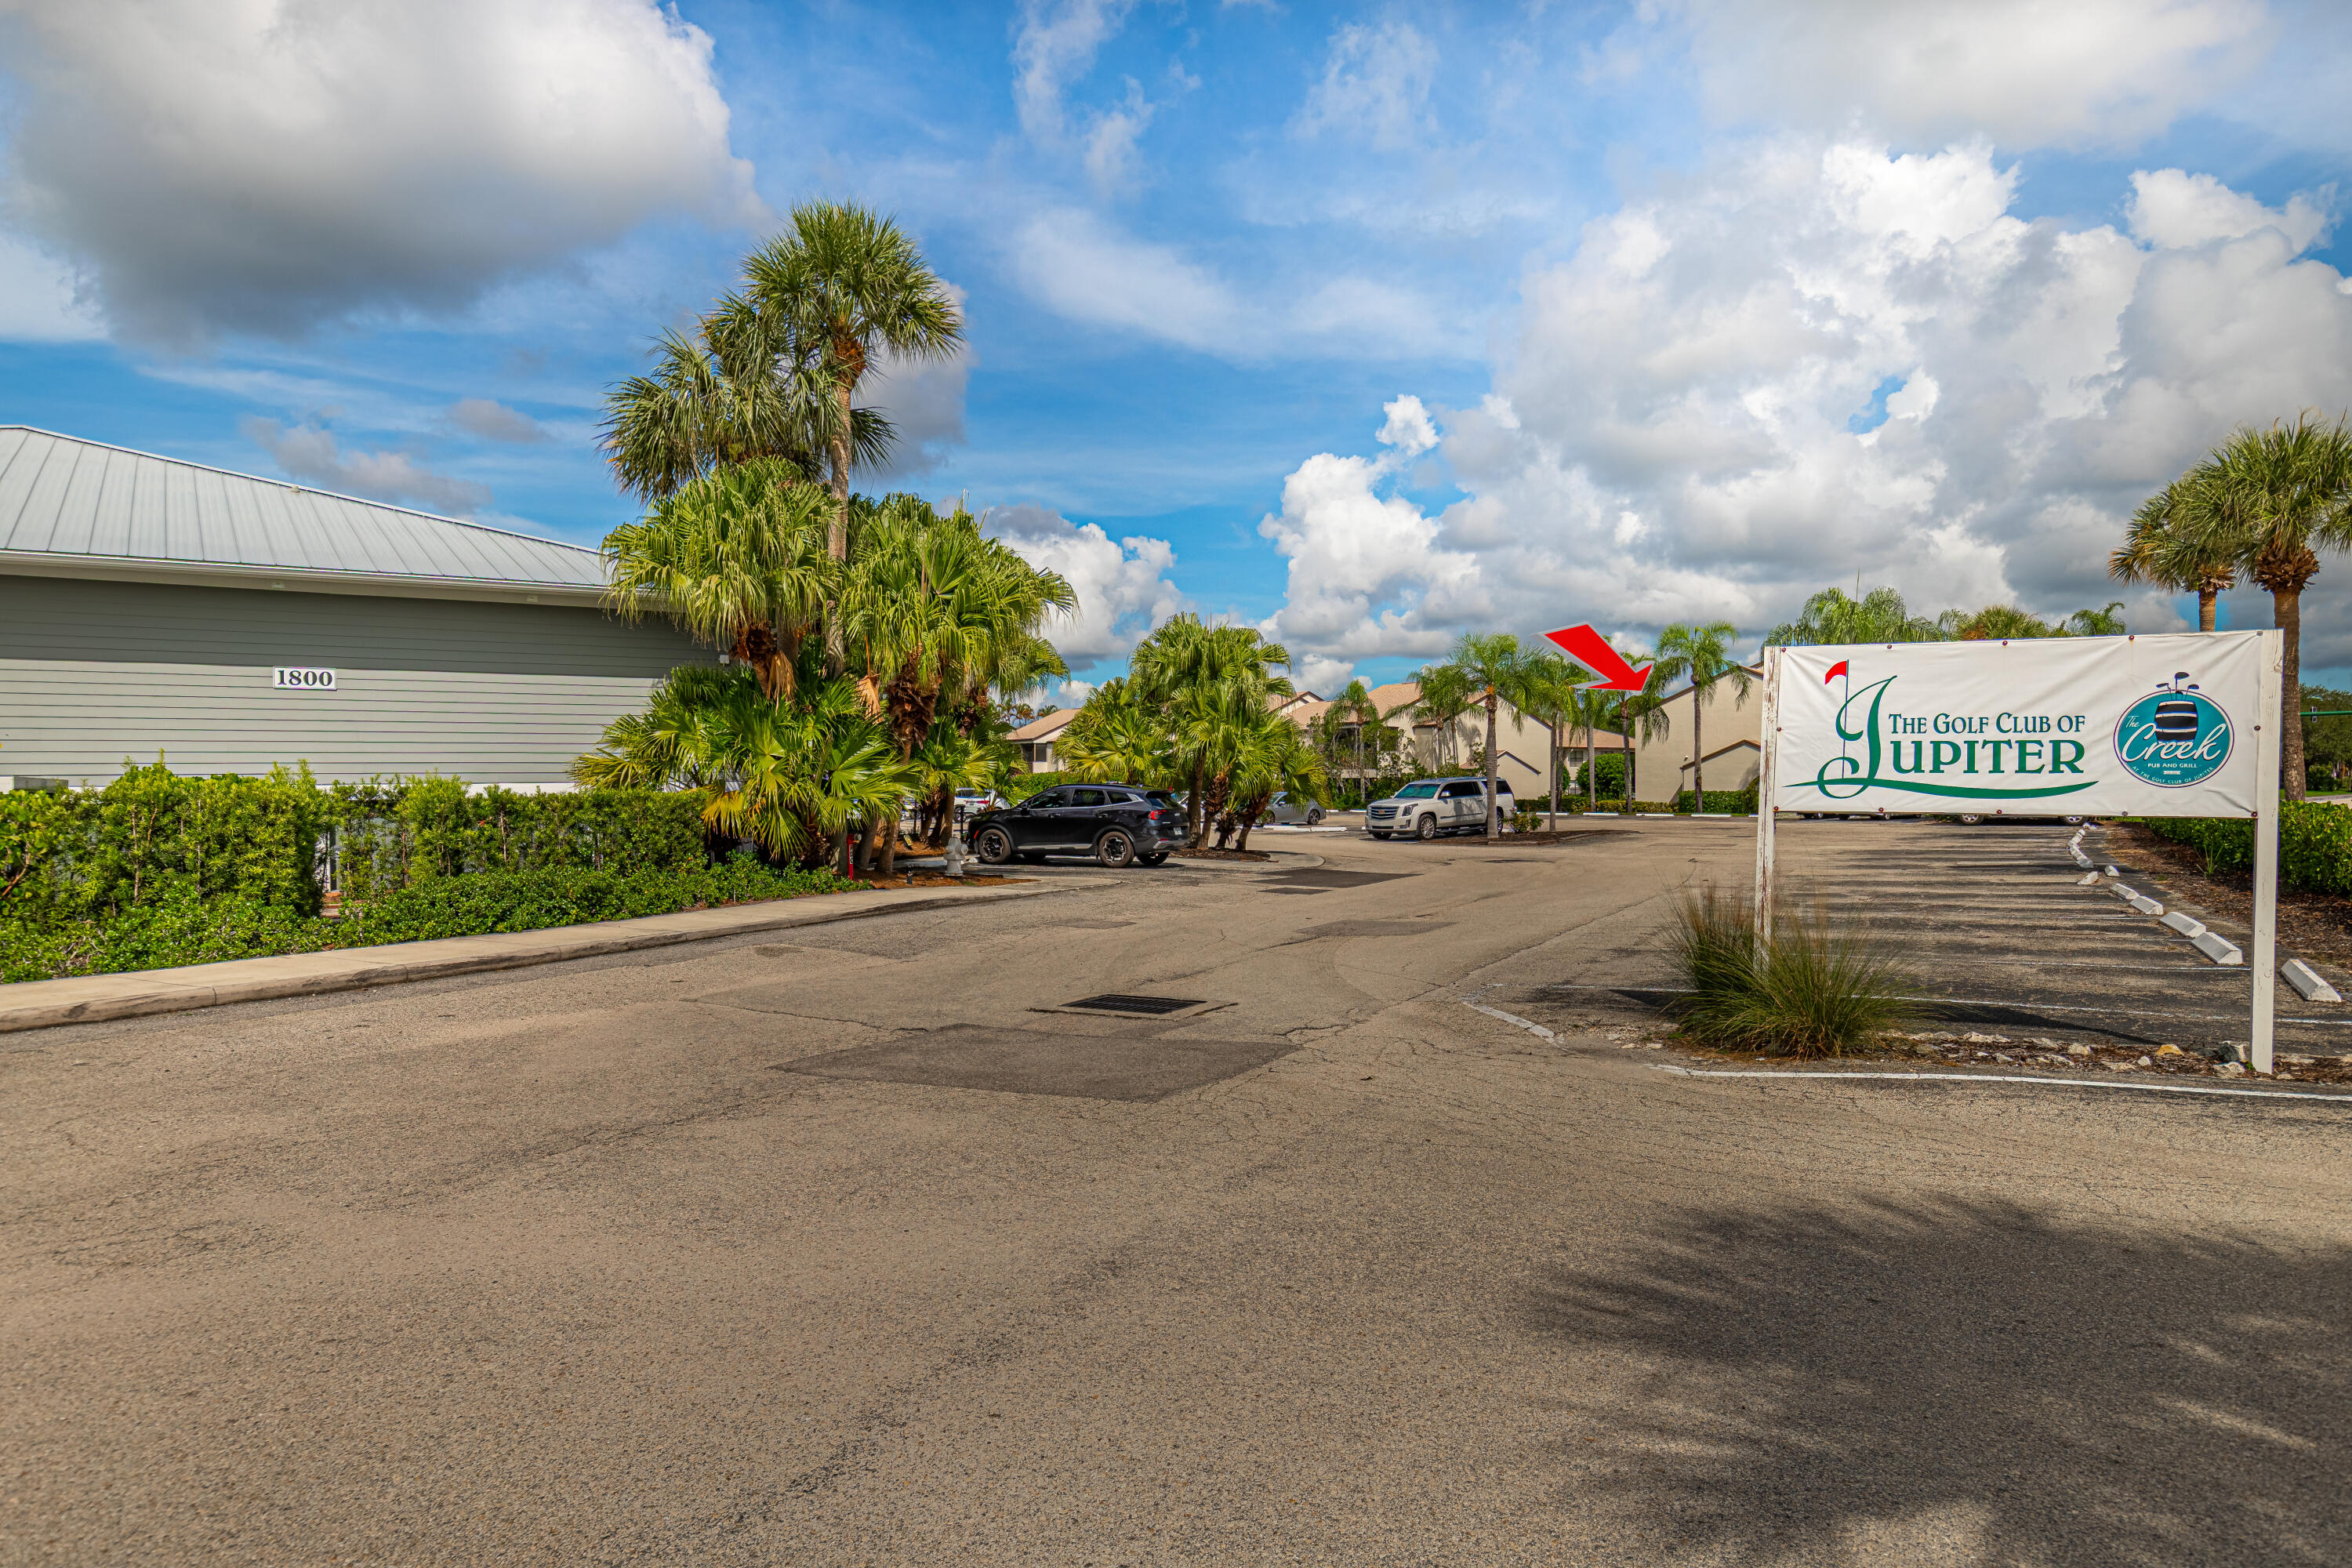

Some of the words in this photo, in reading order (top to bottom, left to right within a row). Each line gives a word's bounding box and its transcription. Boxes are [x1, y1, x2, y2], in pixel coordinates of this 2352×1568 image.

[277, 670, 333, 687] 1800
[1888, 713, 1927, 735] THE
[1933, 712, 1990, 735] GOLF
[1995, 712, 2051, 734] CLUB
[2056, 714, 2086, 734] OF
[2125, 715, 2140, 728] The
[1817, 675, 2086, 799] JUPITER
[2121, 722, 2227, 762] Creek
